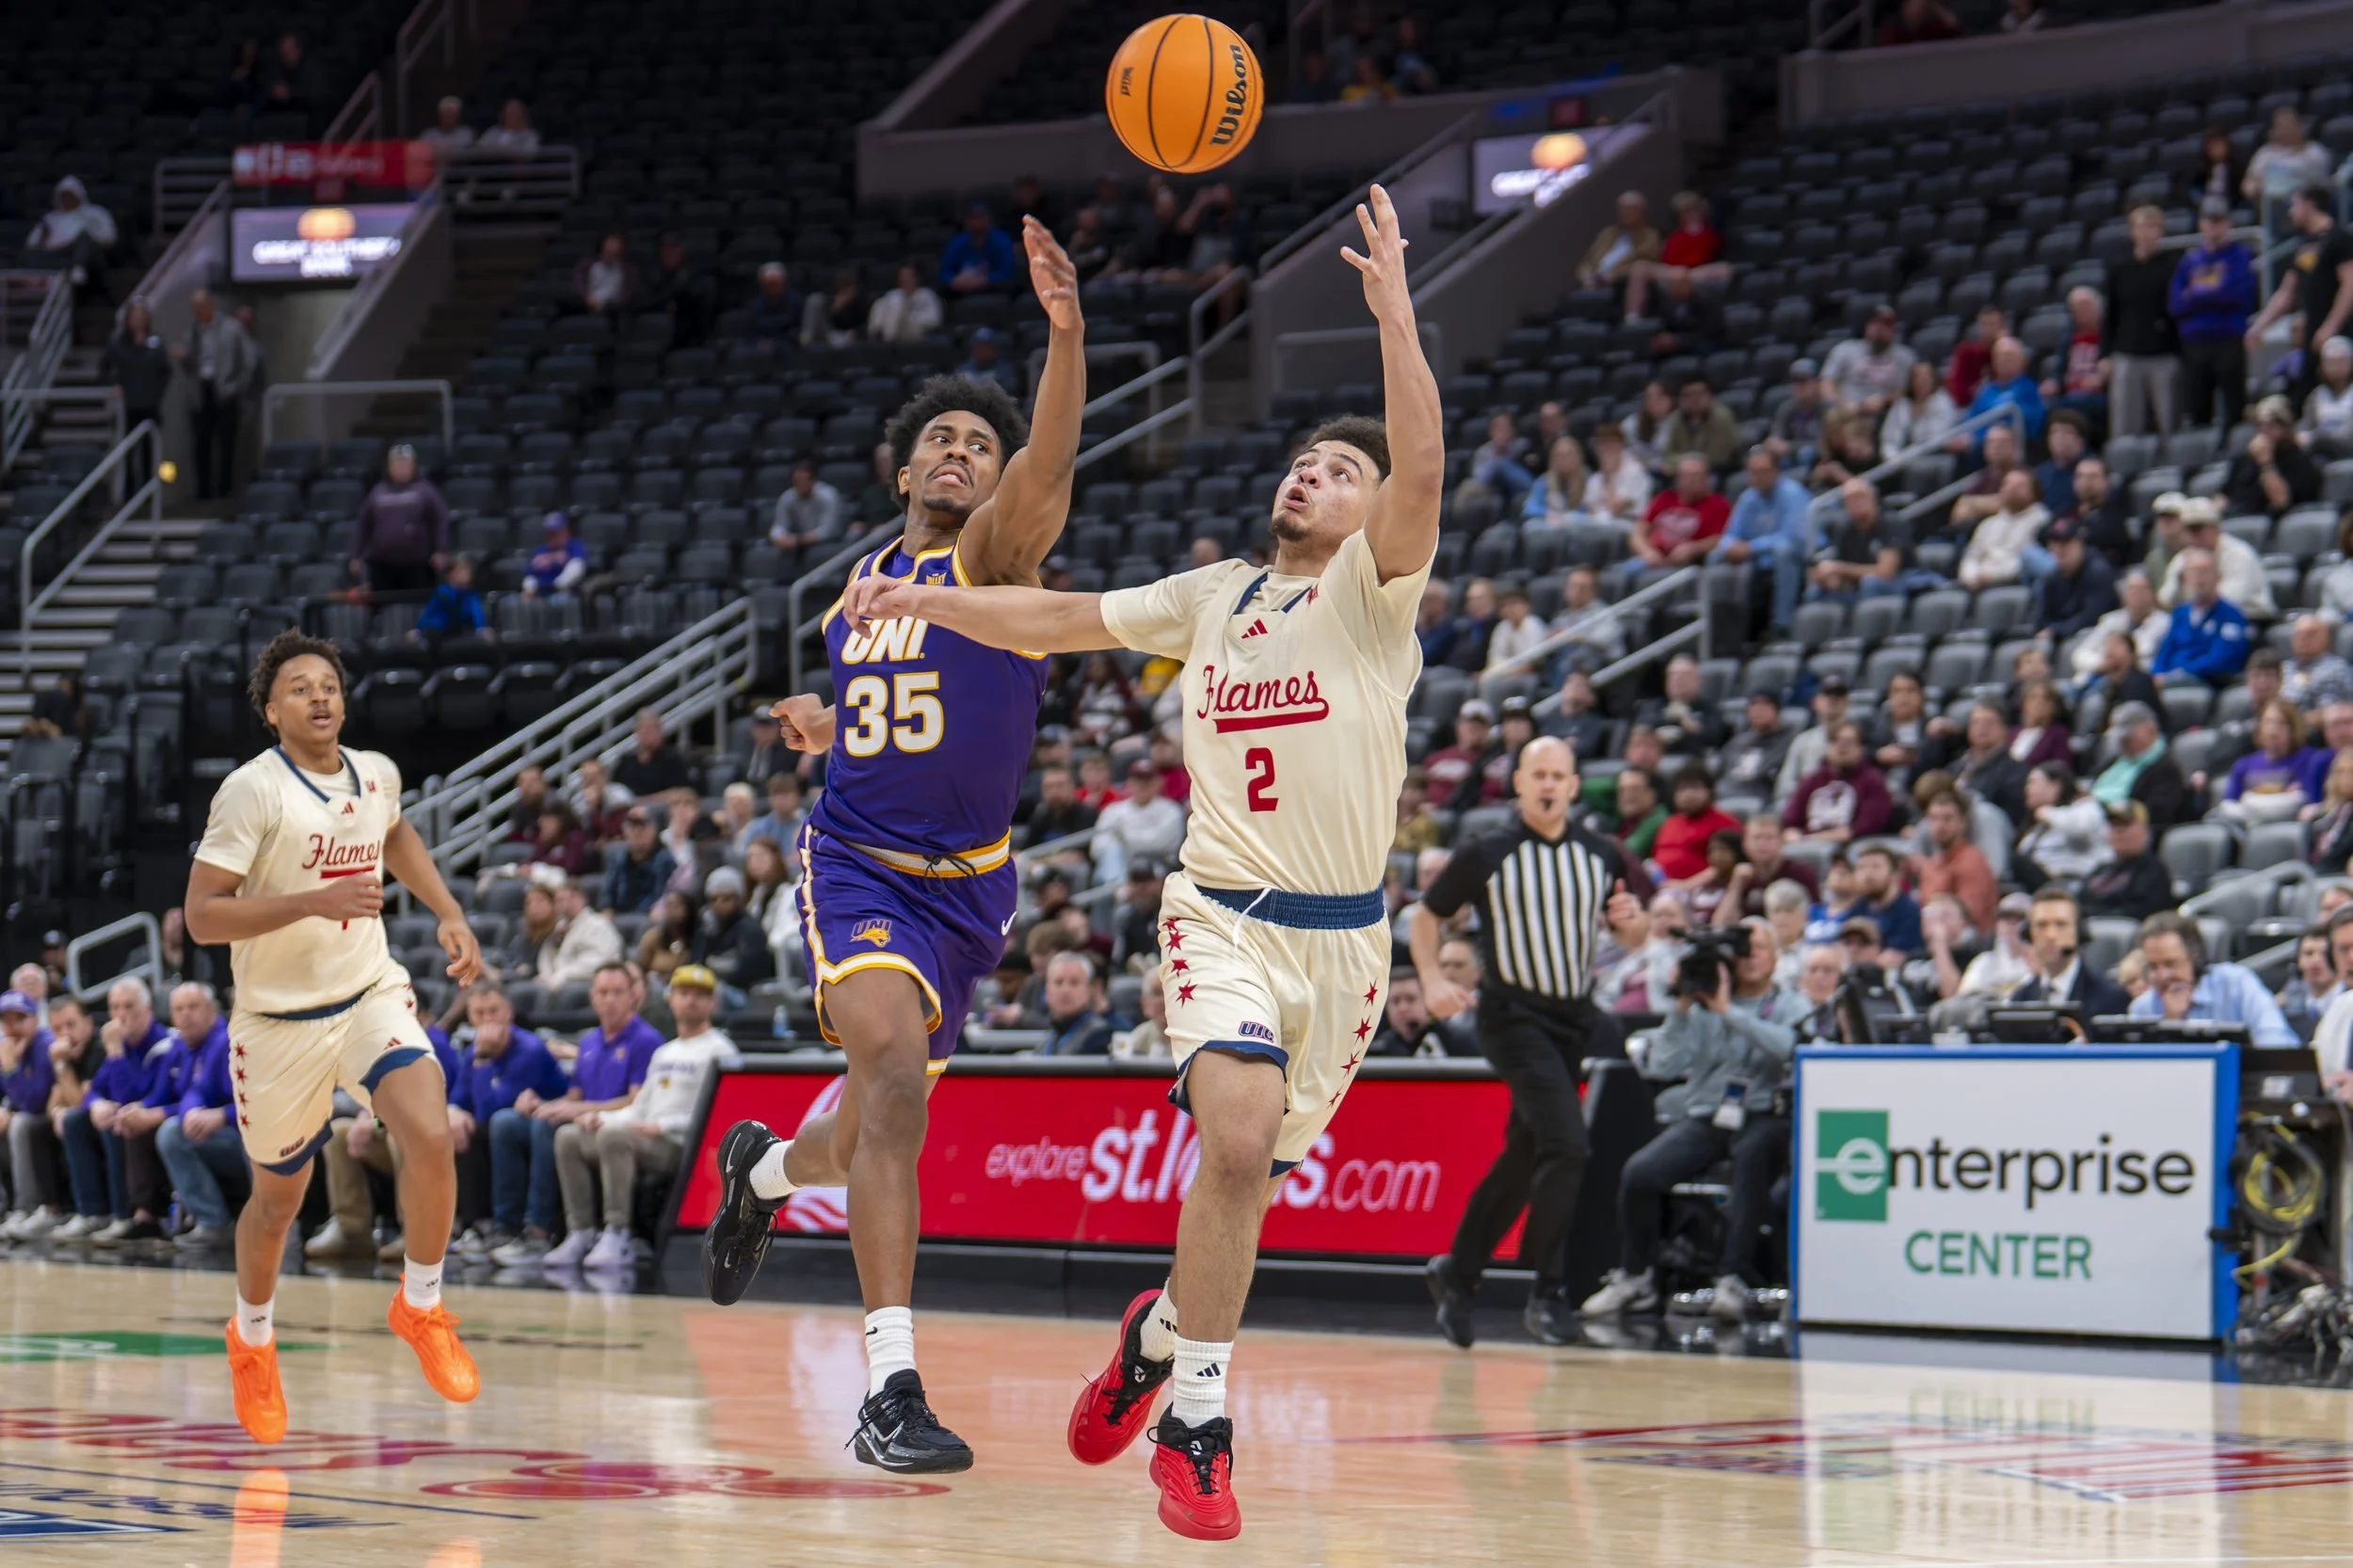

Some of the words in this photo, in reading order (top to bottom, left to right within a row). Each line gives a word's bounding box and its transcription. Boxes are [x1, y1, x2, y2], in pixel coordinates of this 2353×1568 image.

[1209, 44, 1247, 145] Wilson
[844, 671, 944, 758] 35
[1197, 664, 1329, 725] Flames
[1245, 747, 1279, 812] 2
[1239, 1021, 1274, 1043] UIC
[1817, 1133, 2195, 1210] enterprise
[1904, 1230, 2092, 1280] CENTER
